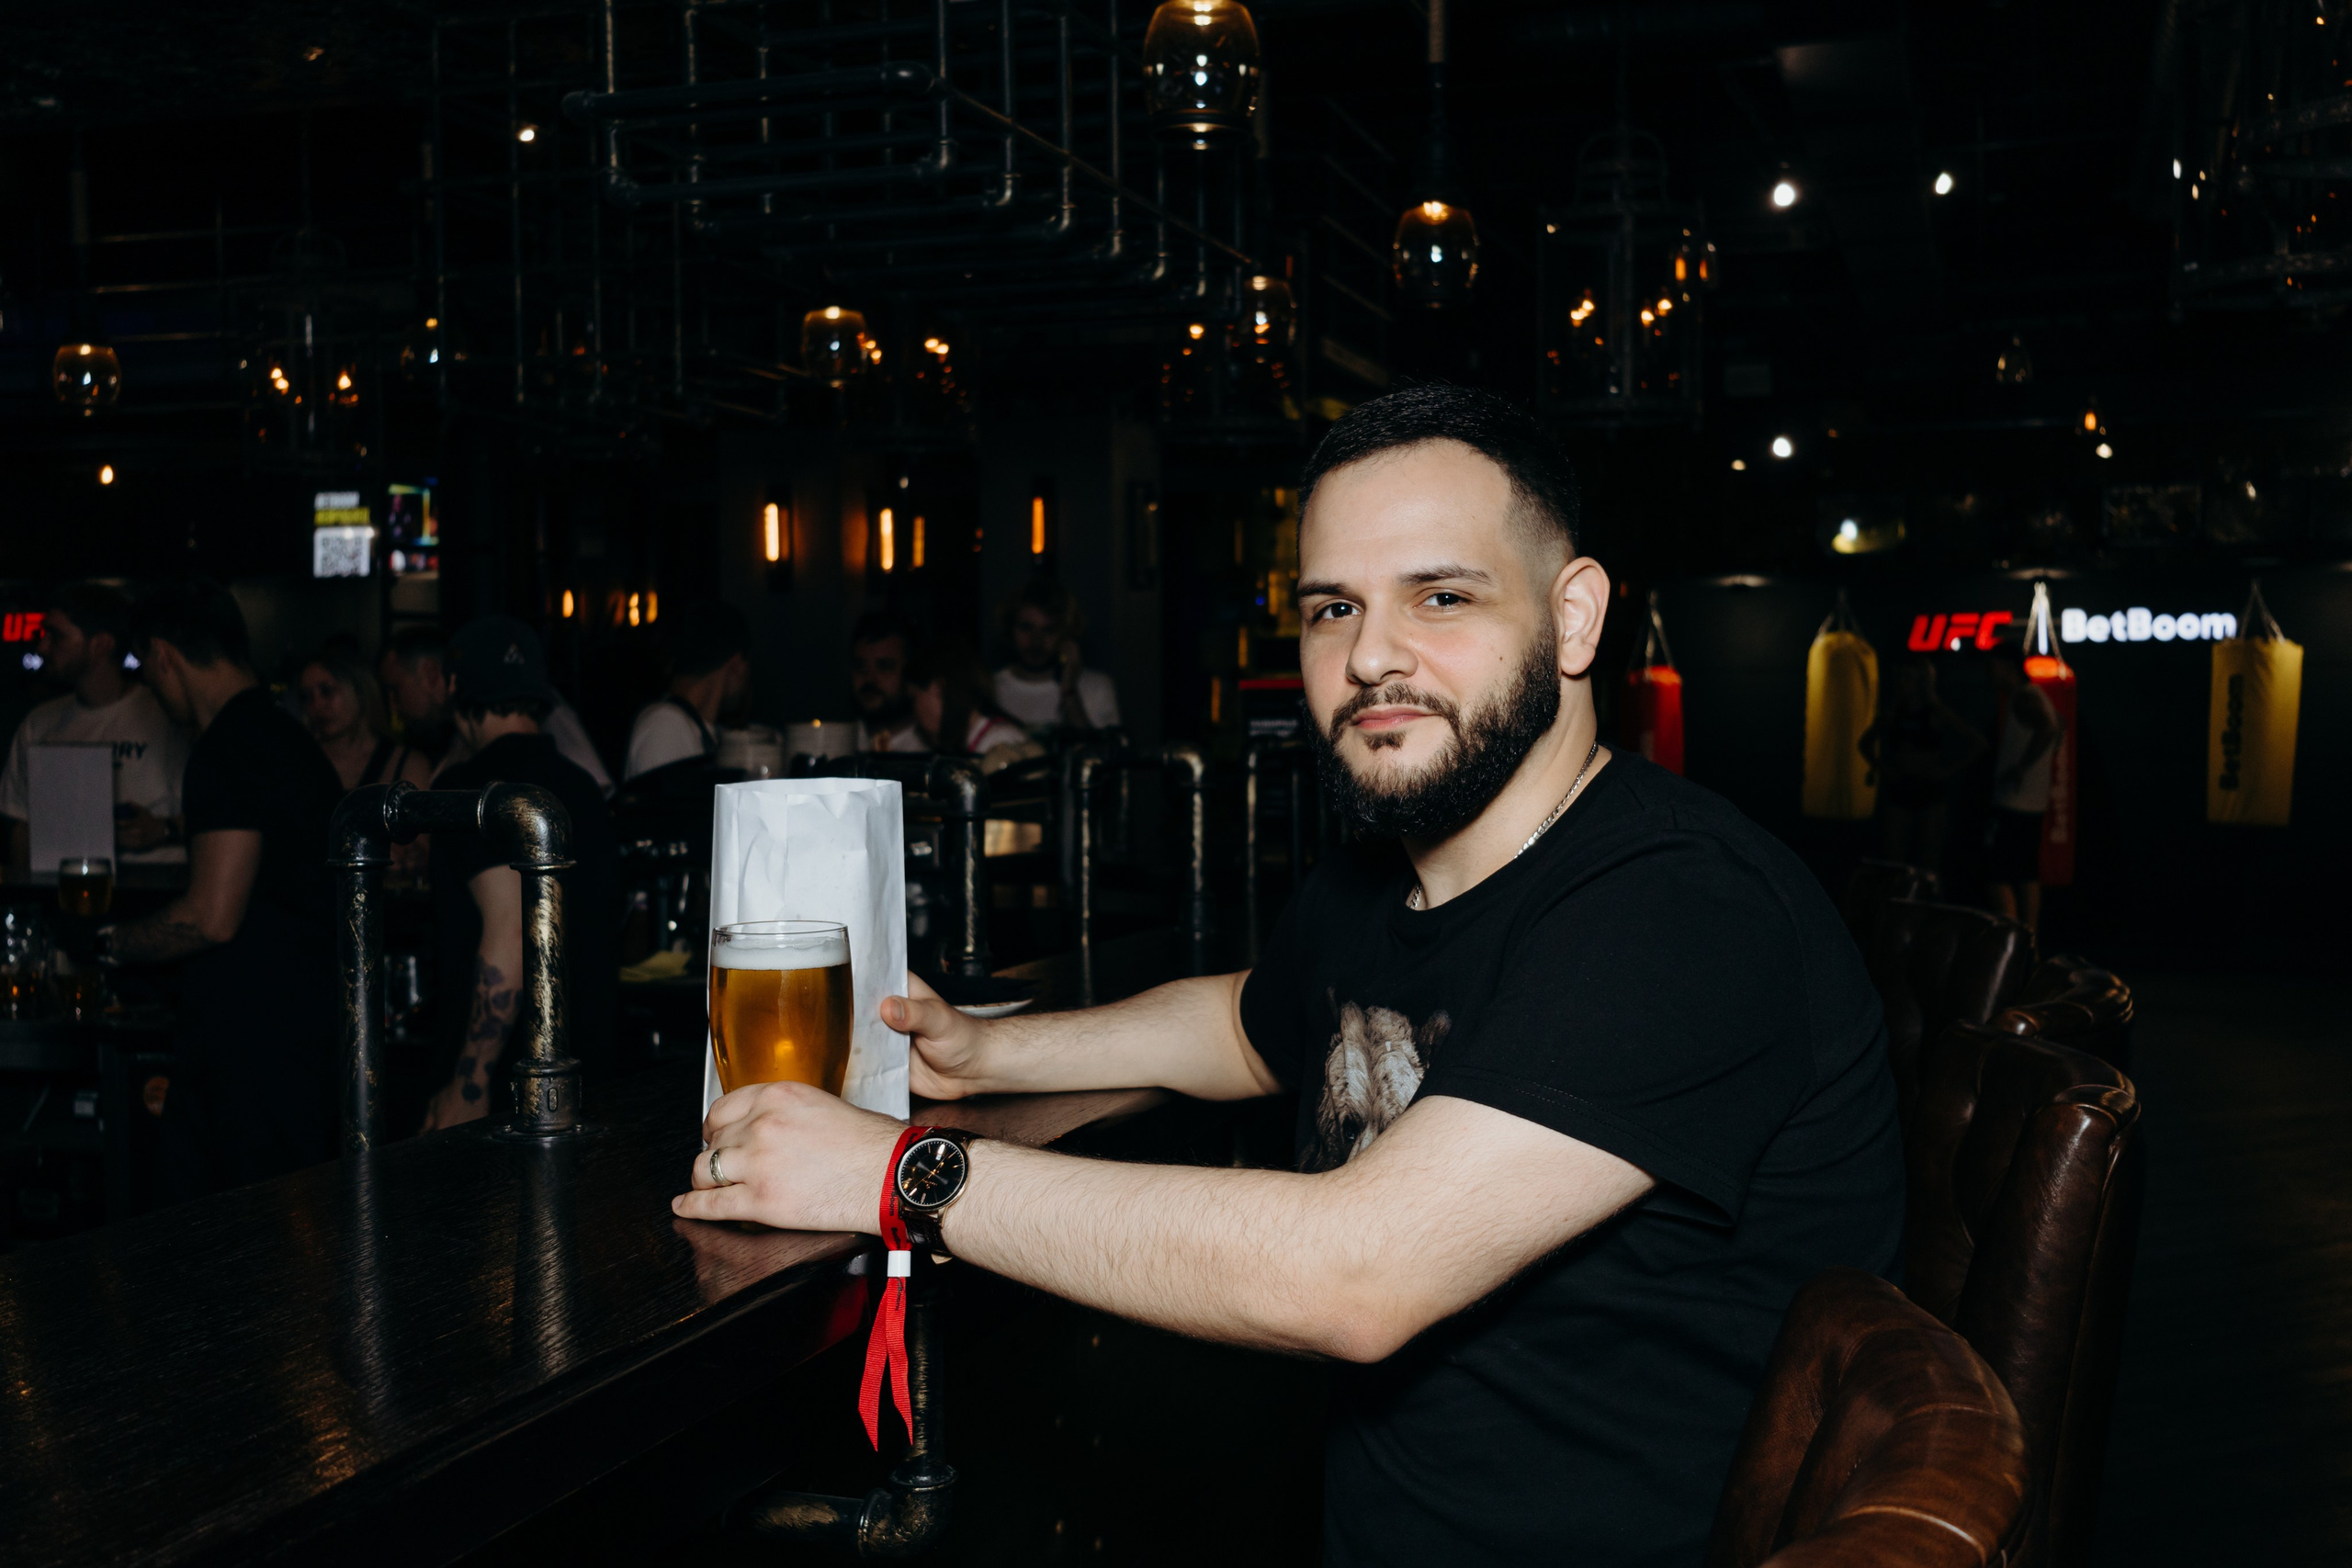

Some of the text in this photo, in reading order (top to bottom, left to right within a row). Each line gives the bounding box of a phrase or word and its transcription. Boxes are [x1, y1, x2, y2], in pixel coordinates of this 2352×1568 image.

[3, 613, 46, 642] UF
[1907, 606, 2238, 651] UFC BetBoom
